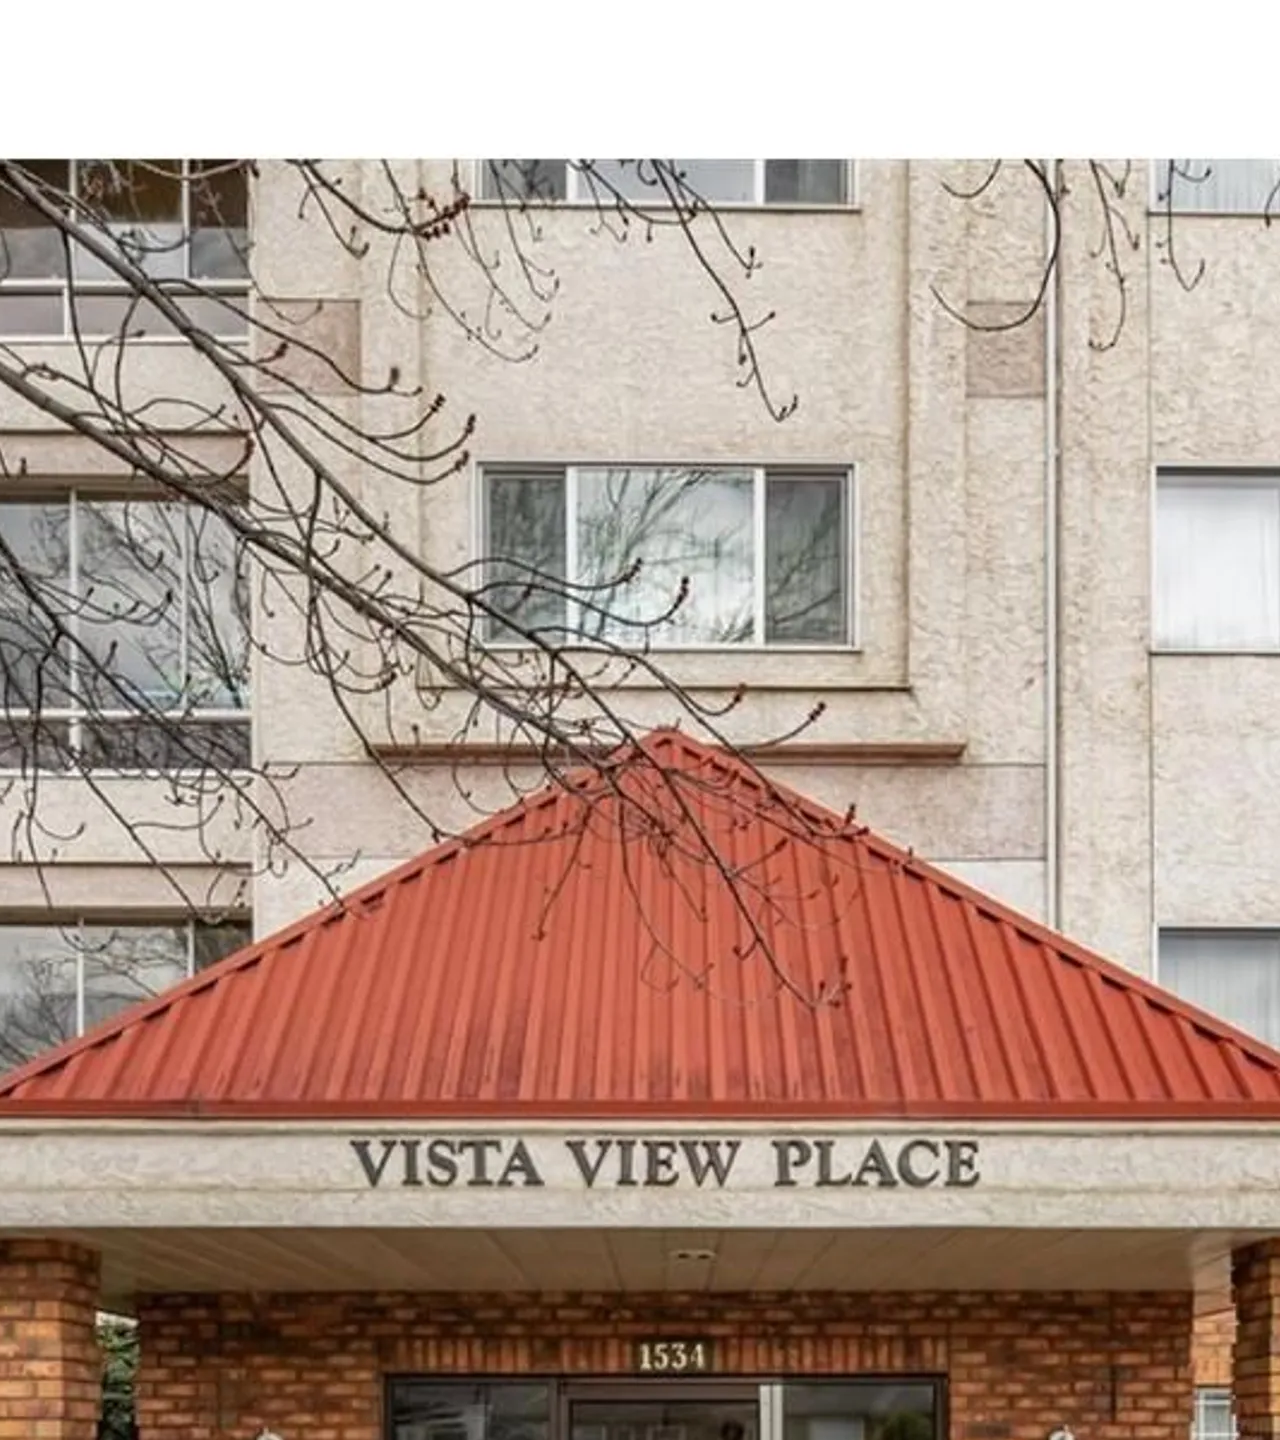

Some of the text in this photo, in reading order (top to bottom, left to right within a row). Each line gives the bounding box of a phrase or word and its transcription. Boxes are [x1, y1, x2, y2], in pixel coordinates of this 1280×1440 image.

[350, 1138, 981, 1189] VISTA VIEW PLACE
[640, 1343, 705, 1370] 1534
